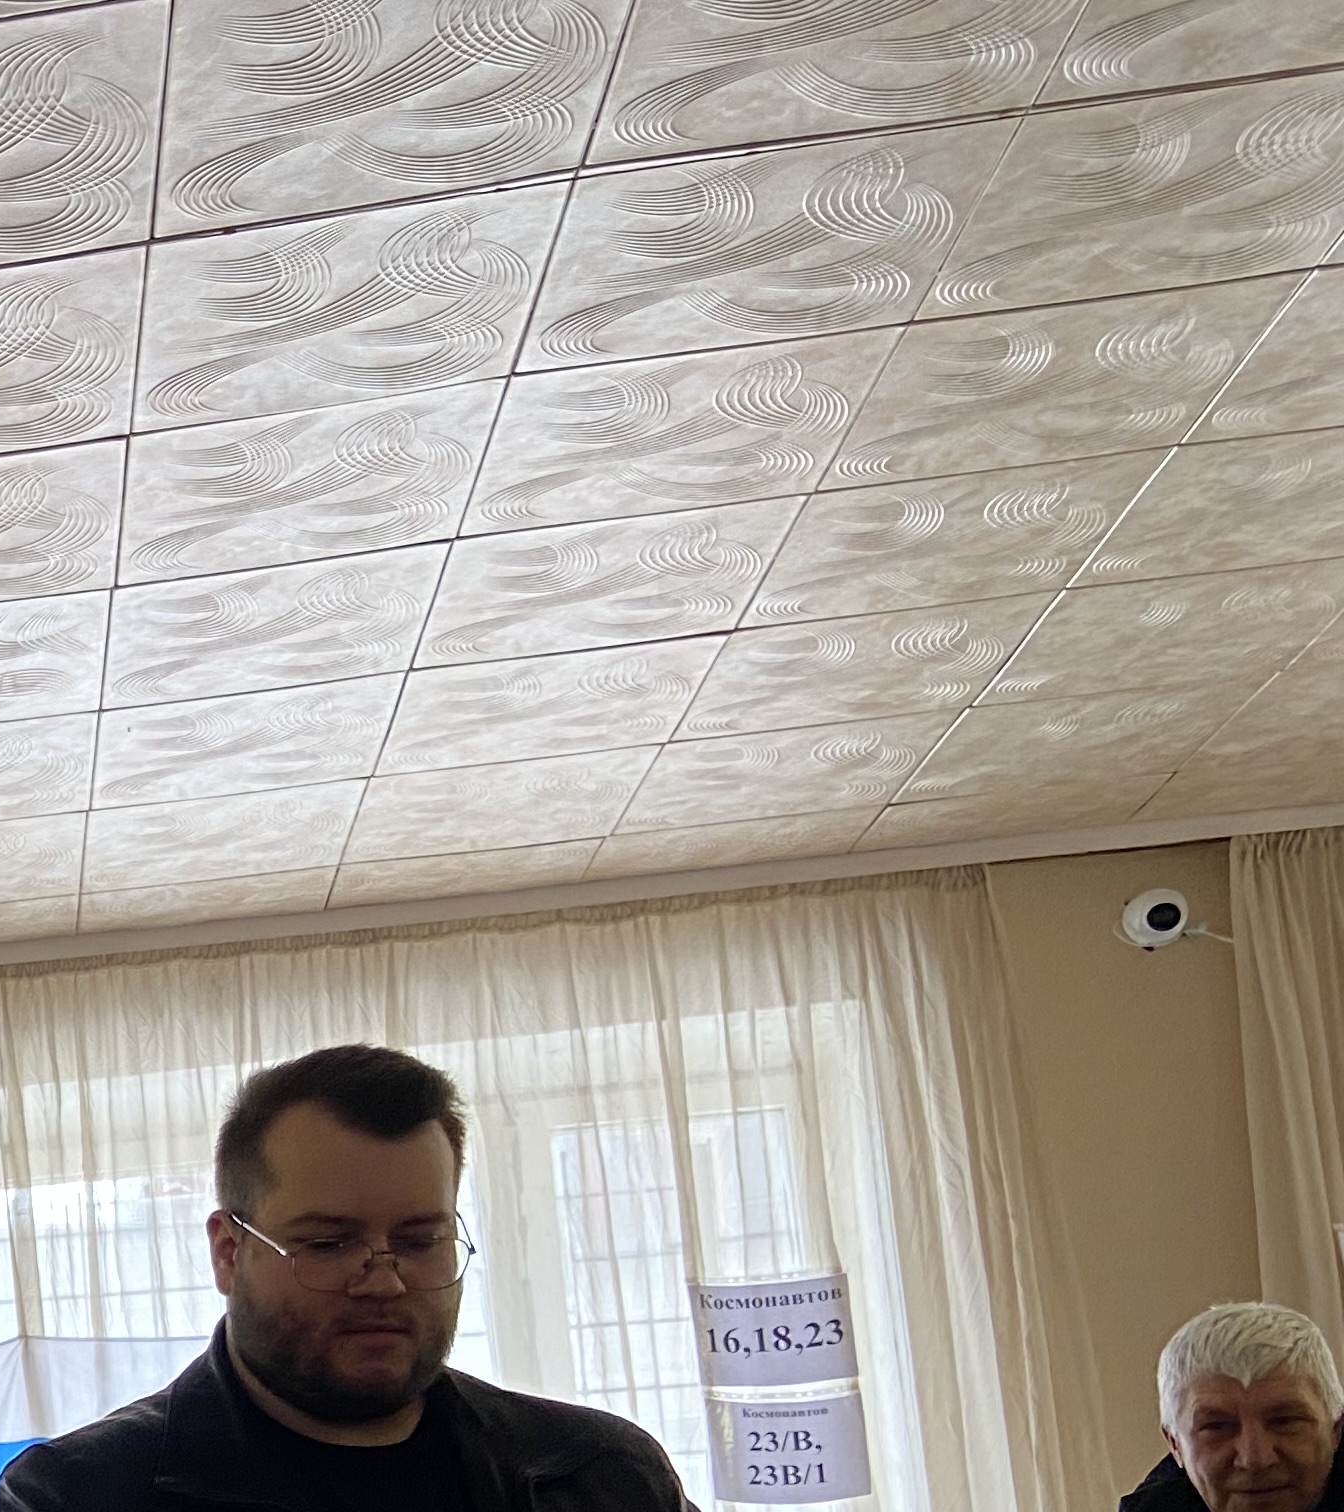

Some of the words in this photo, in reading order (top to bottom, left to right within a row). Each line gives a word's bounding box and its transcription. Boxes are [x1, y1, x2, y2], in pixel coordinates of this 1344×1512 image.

[699, 1287, 843, 1310] Космонавтов
[707, 1318, 844, 1359] 16,18,23
[742, 1407, 829, 1419] Космонавтов
[747, 1430, 823, 1454] 23/В,
[747, 1463, 828, 1485] 23В/1
